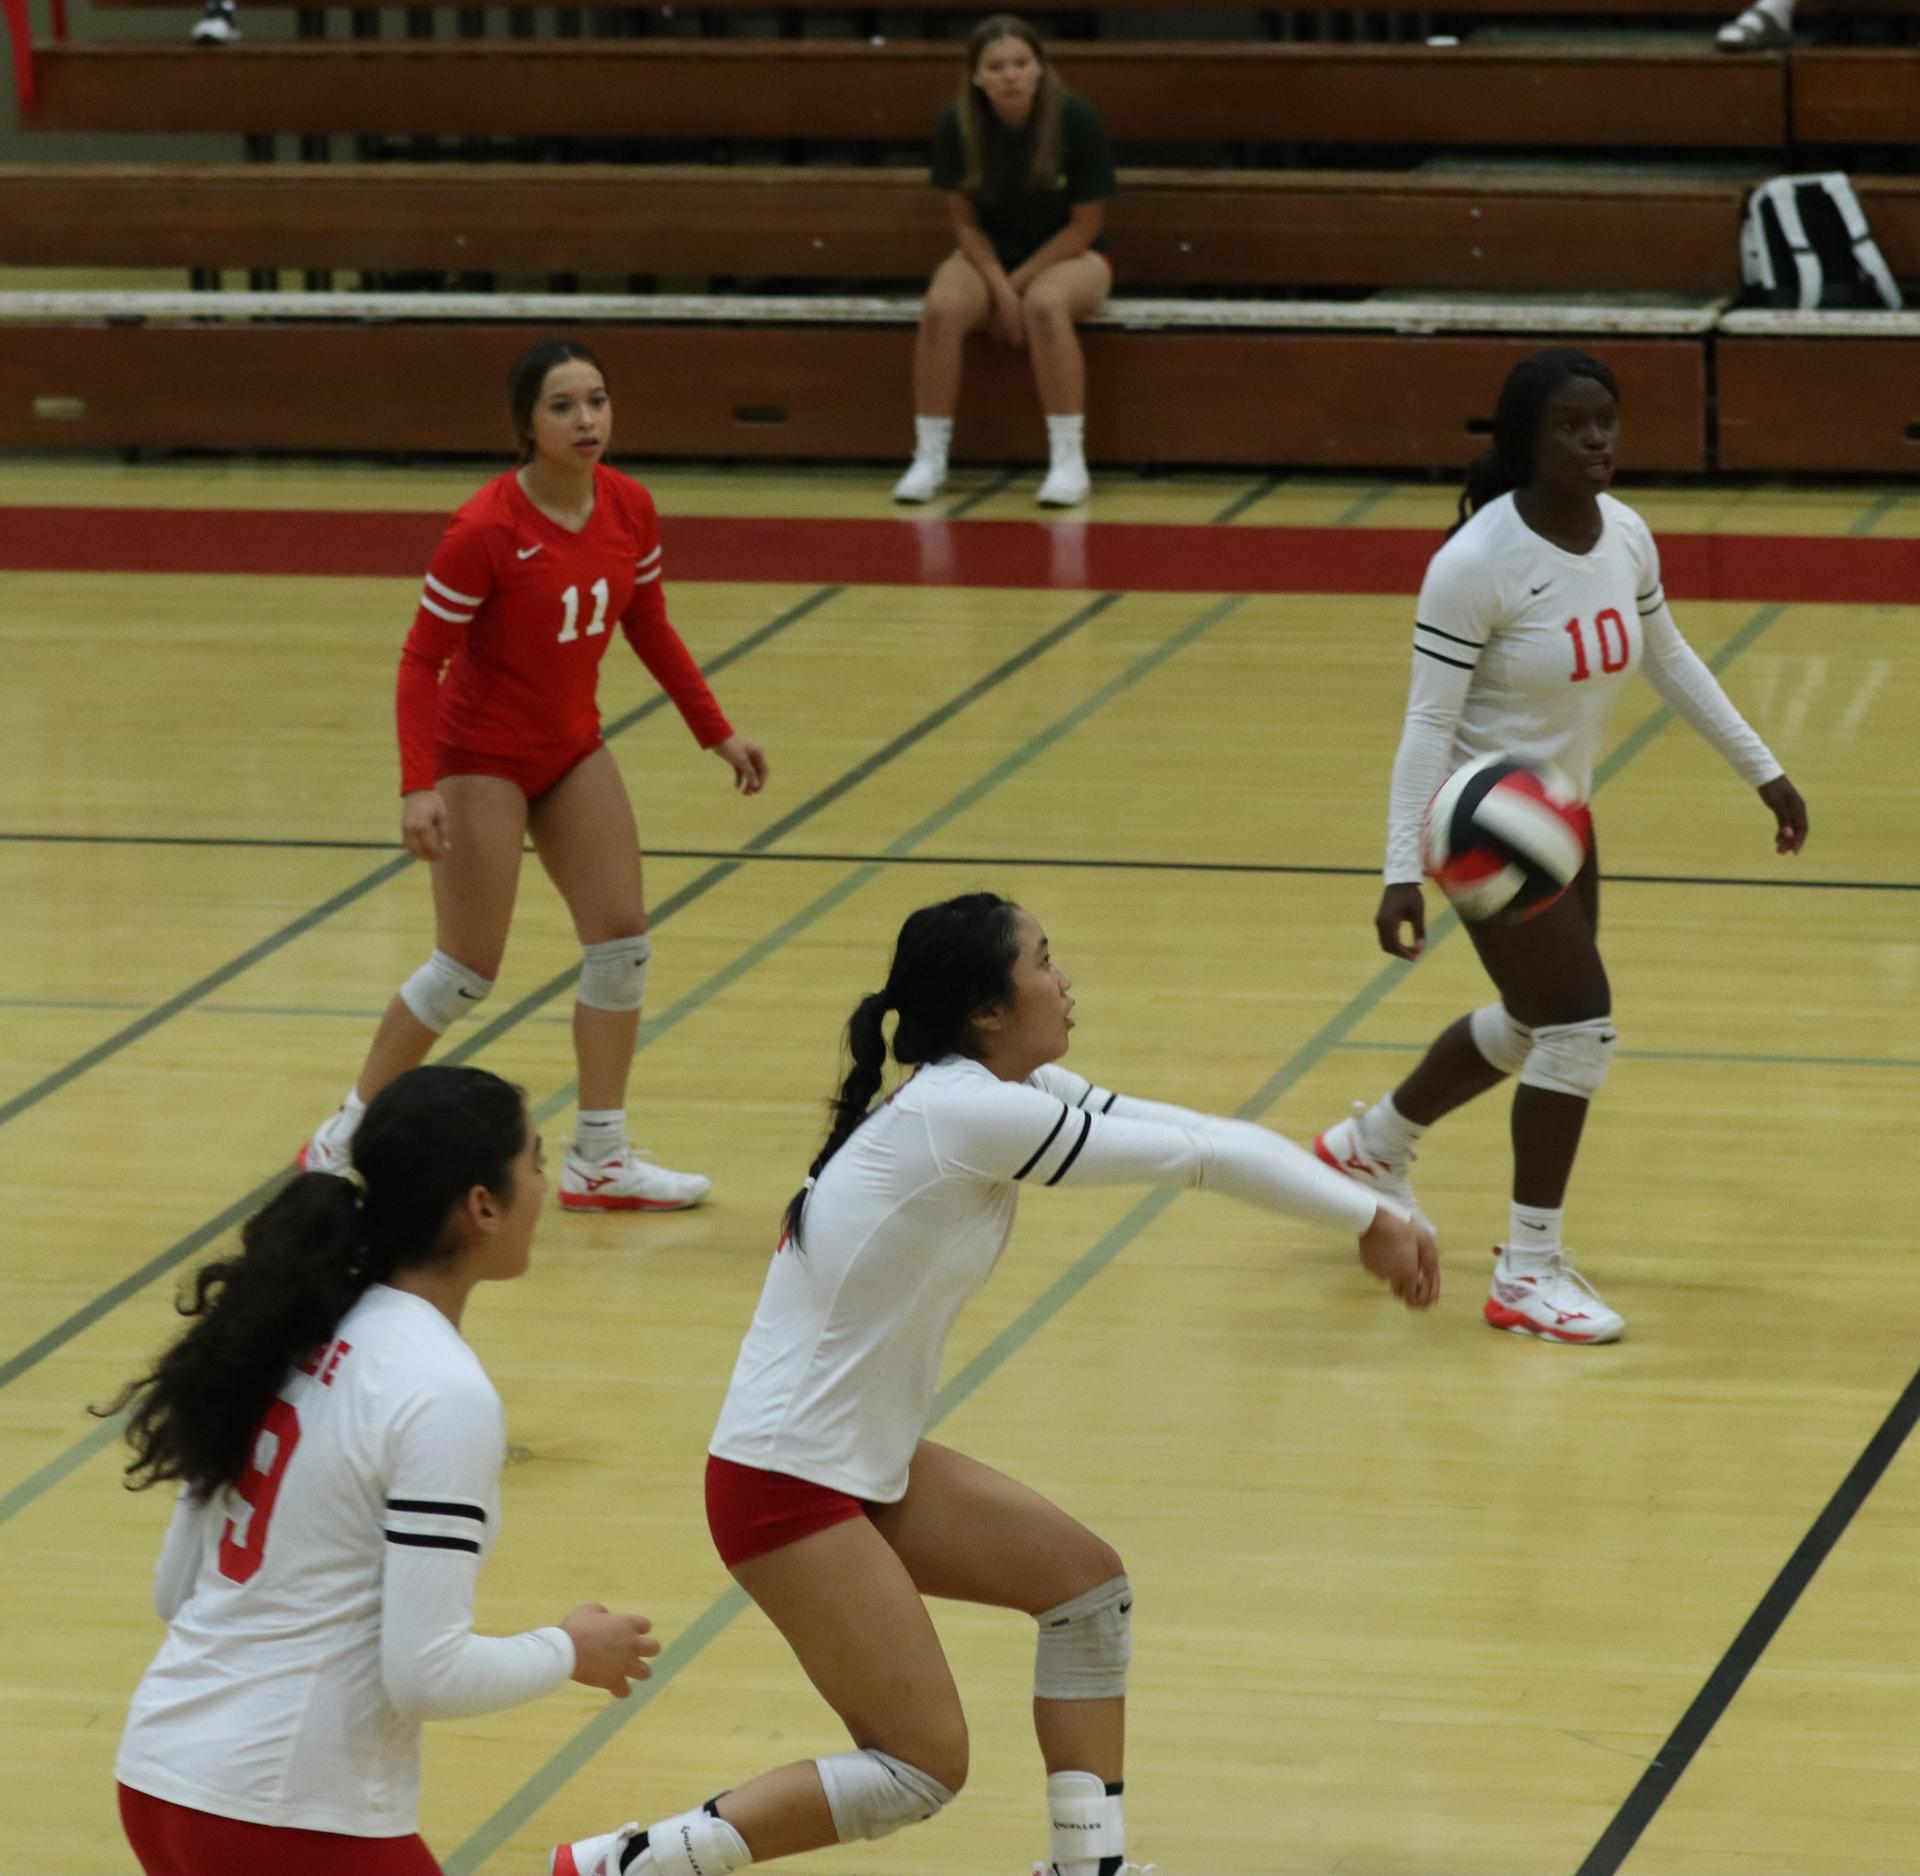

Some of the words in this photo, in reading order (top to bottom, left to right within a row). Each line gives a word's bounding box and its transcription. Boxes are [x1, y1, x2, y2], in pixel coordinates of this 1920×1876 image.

[557, 577, 609, 643] 11
[1564, 608, 1630, 682] 10
[218, 1396, 303, 1585] 9
